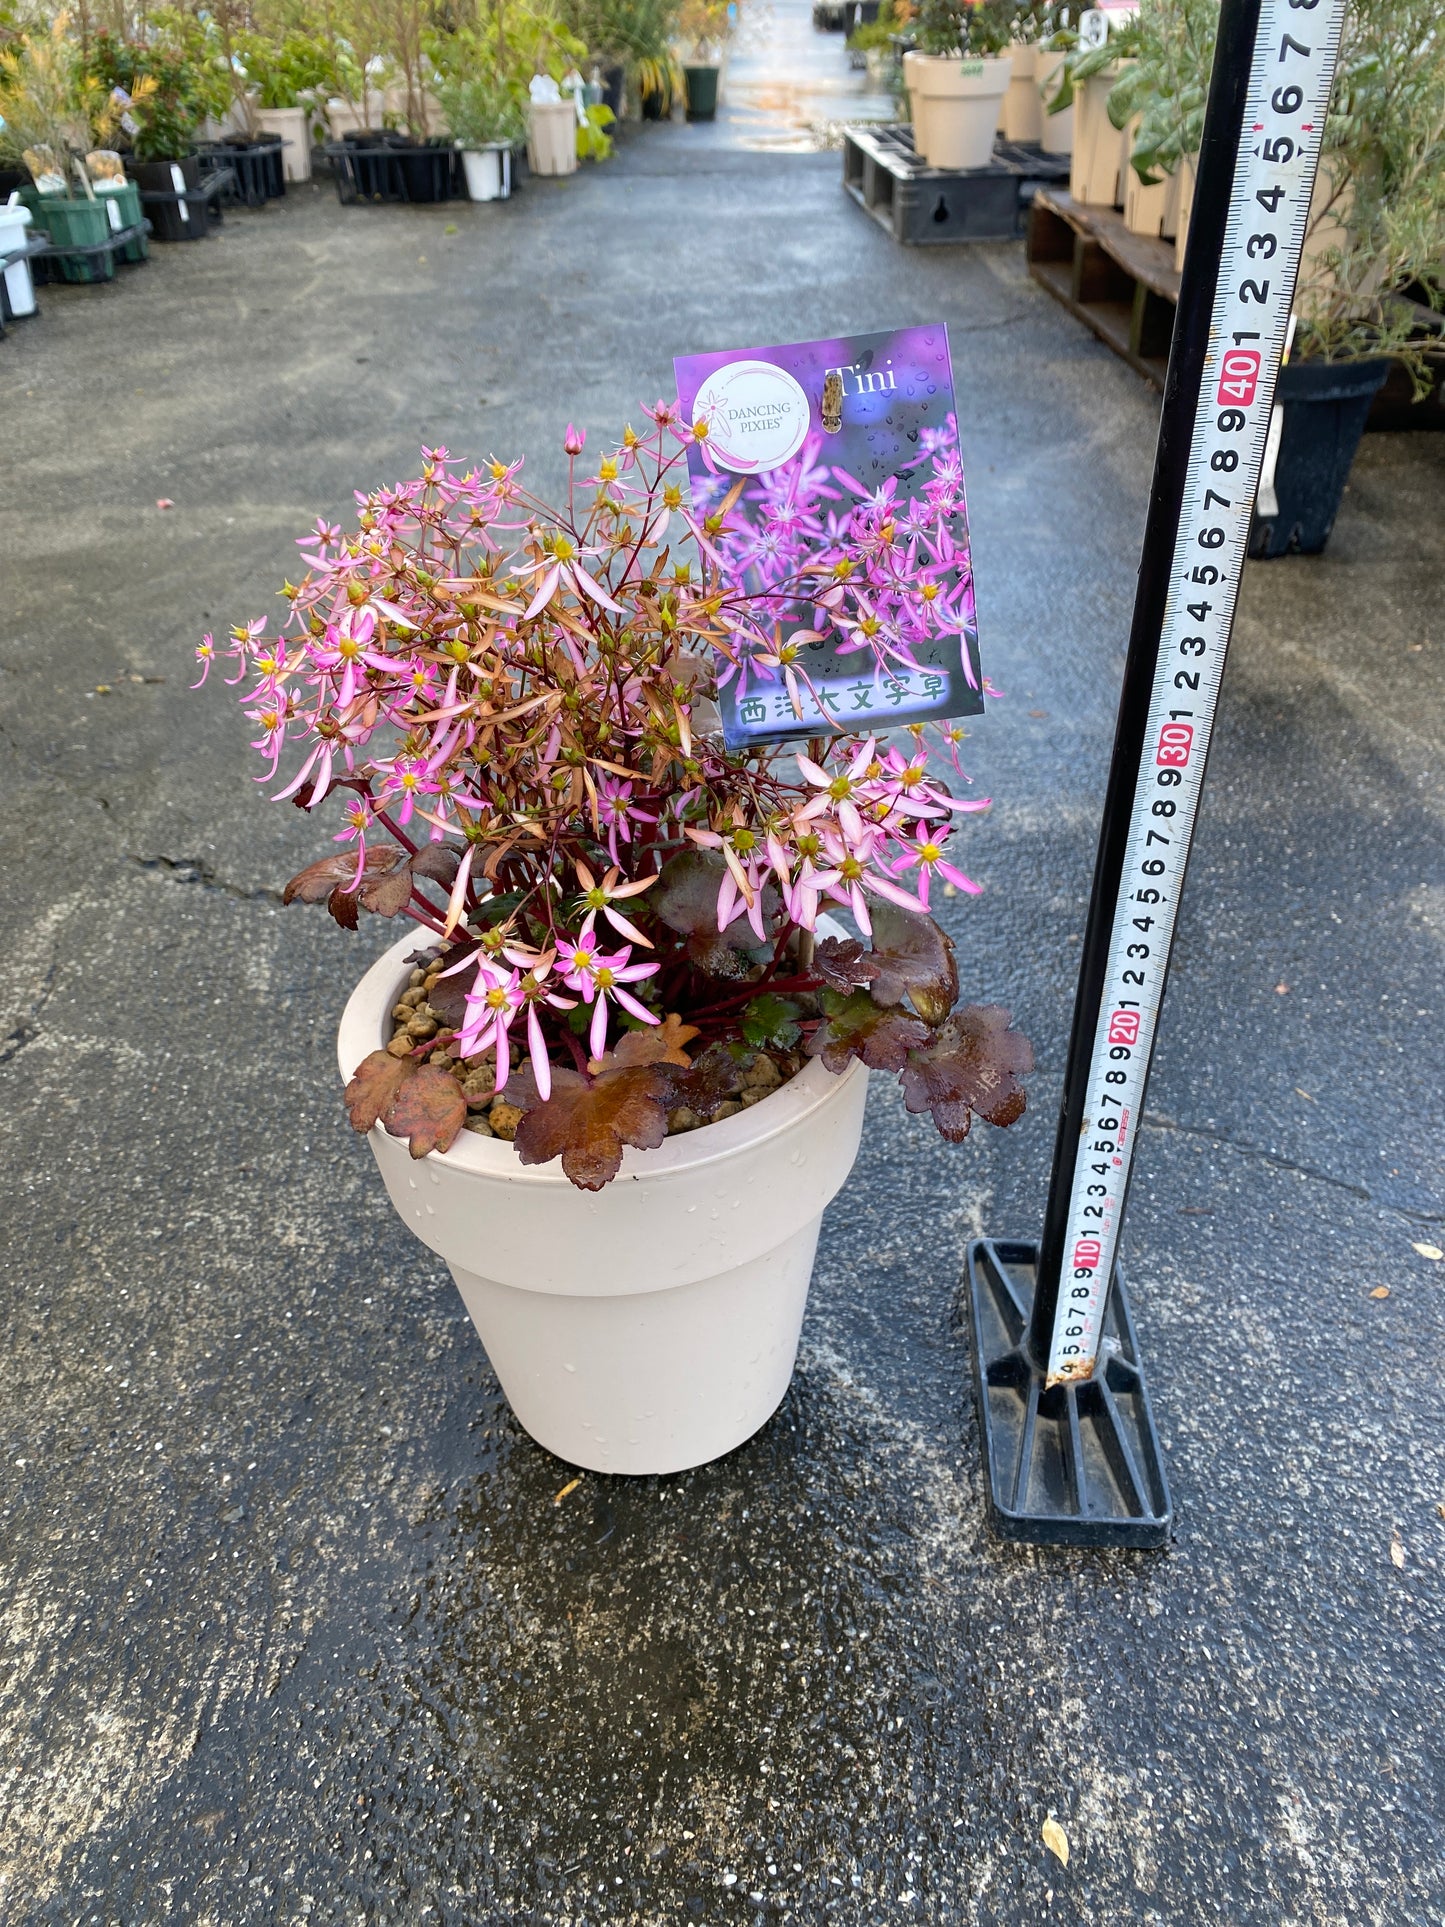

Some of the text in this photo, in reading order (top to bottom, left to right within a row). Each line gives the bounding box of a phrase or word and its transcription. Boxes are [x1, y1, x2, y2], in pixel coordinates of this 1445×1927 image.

[1278, 33, 1311, 63] 7
[1271, 85, 1304, 115] 6
[1262, 136, 1295, 164] 5
[1255, 185, 1286, 213] 4
[1246, 233, 1278, 260] 3
[1238, 279, 1270, 305] 2
[1232, 331, 1261, 346] 1
[1222, 356, 1257, 398] 40
[728, 402, 792, 421] DANCING
[1217, 408, 1246, 433] 9
[1210, 449, 1239, 473] 8
[1203, 489, 1231, 511] 7
[1197, 527, 1226, 549] 6
[1191, 565, 1219, 586] 5
[1186, 600, 1213, 623] 4
[1179, 636, 1206, 657] 3
[1173, 670, 1201, 691] 2
[1168, 710, 1194, 721] 1
[1159, 728, 1191, 761] 30
[1156, 768, 1182, 787] 9
[1151, 800, 1177, 818] 8
[1145, 829, 1170, 847] 7
[1141, 859, 1166, 876] 6
[1136, 888, 1160, 905] 5
[1132, 916, 1155, 933] 4
[1126, 943, 1150, 960] 3
[1122, 970, 1146, 986] 2
[1118, 1000, 1140, 1009] 1
[1111, 1014, 1137, 1040] 20
[1109, 1046, 1131, 1061] 9
[1105, 1070, 1127, 1085] 8
[1101, 1094, 1122, 1107] 7
[1097, 1117, 1119, 1131] 6
[1093, 1140, 1115, 1153] 5
[1091, 1162, 1111, 1176] 4
[1086, 1184, 1107, 1197] 3
[1083, 1205, 1104, 1218] 2
[1075, 1242, 1098, 1262] 10
[1074, 1266, 1093, 1279] 9
[1071, 1287, 1090, 1298] 8
[1068, 1307, 1086, 1318] 7
[1065, 1326, 1083, 1337] 6
[1062, 1344, 1080, 1355] 5
[1060, 1363, 1078, 1374] 4
